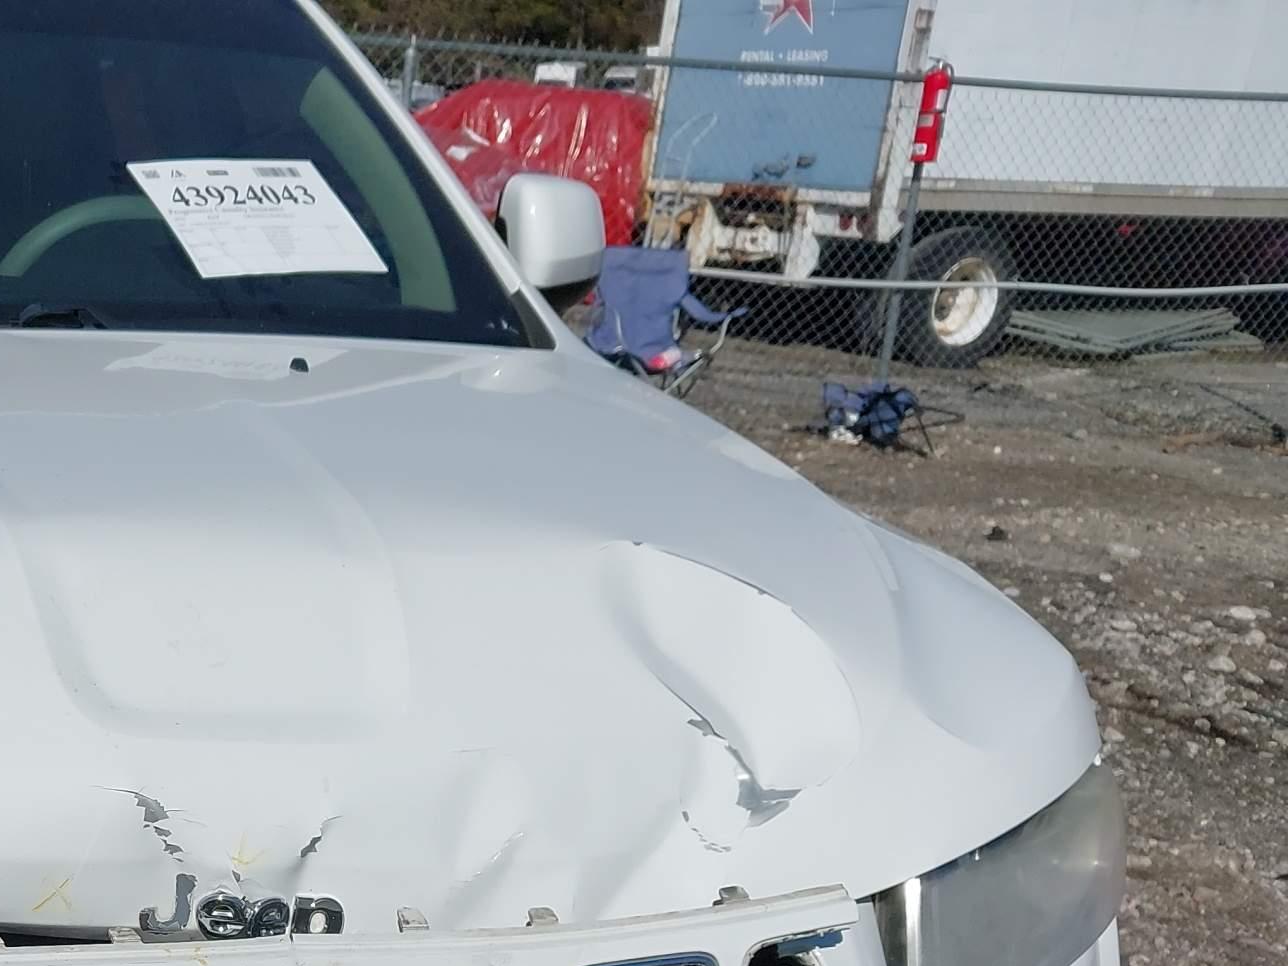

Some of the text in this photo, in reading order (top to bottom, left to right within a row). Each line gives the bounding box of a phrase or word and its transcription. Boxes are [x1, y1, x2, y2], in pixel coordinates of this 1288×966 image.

[740, 49, 829, 63] RENTAL LEASING
[171, 183, 317, 207] 43924043
